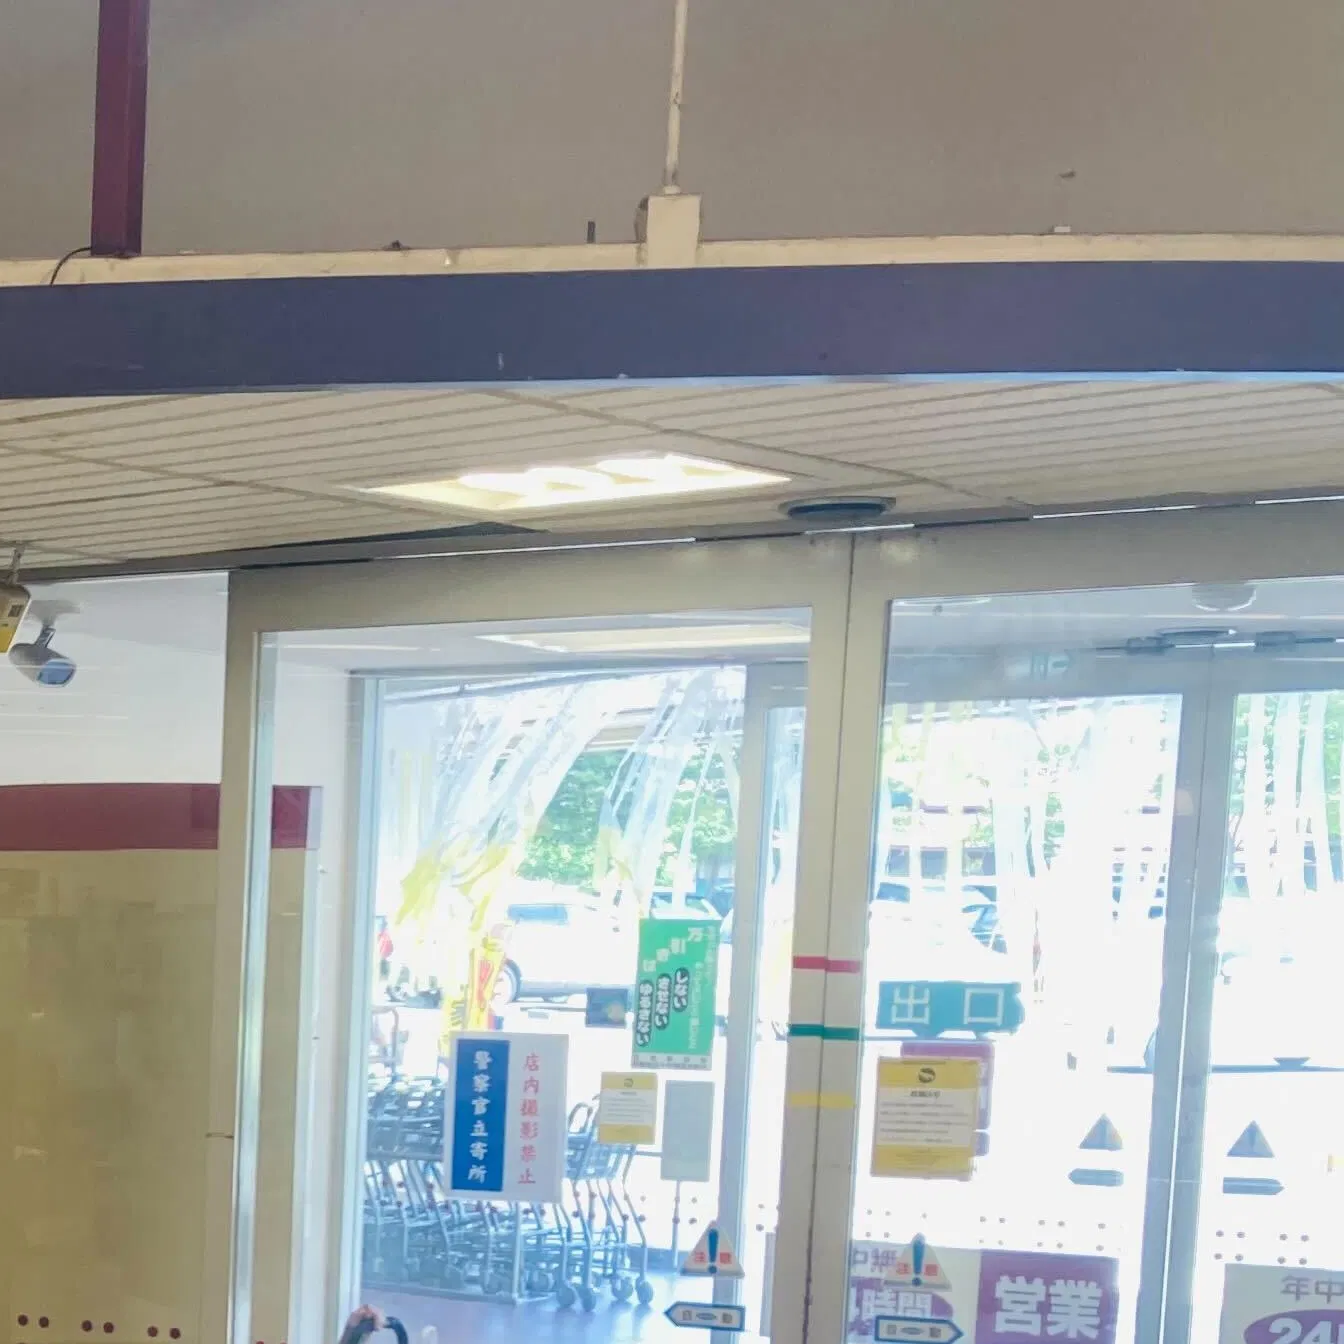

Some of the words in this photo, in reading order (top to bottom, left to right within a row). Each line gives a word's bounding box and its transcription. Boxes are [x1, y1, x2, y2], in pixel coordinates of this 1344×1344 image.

[890, 983, 1005, 1027] 出口
[466, 1049, 494, 1184] 警察官立寄所
[517, 1052, 542, 1186] 店内撮影禁止
[851, 1247, 900, 1272] 中無
[851, 1287, 934, 1319] 時間
[993, 1275, 1104, 1341] 営業
